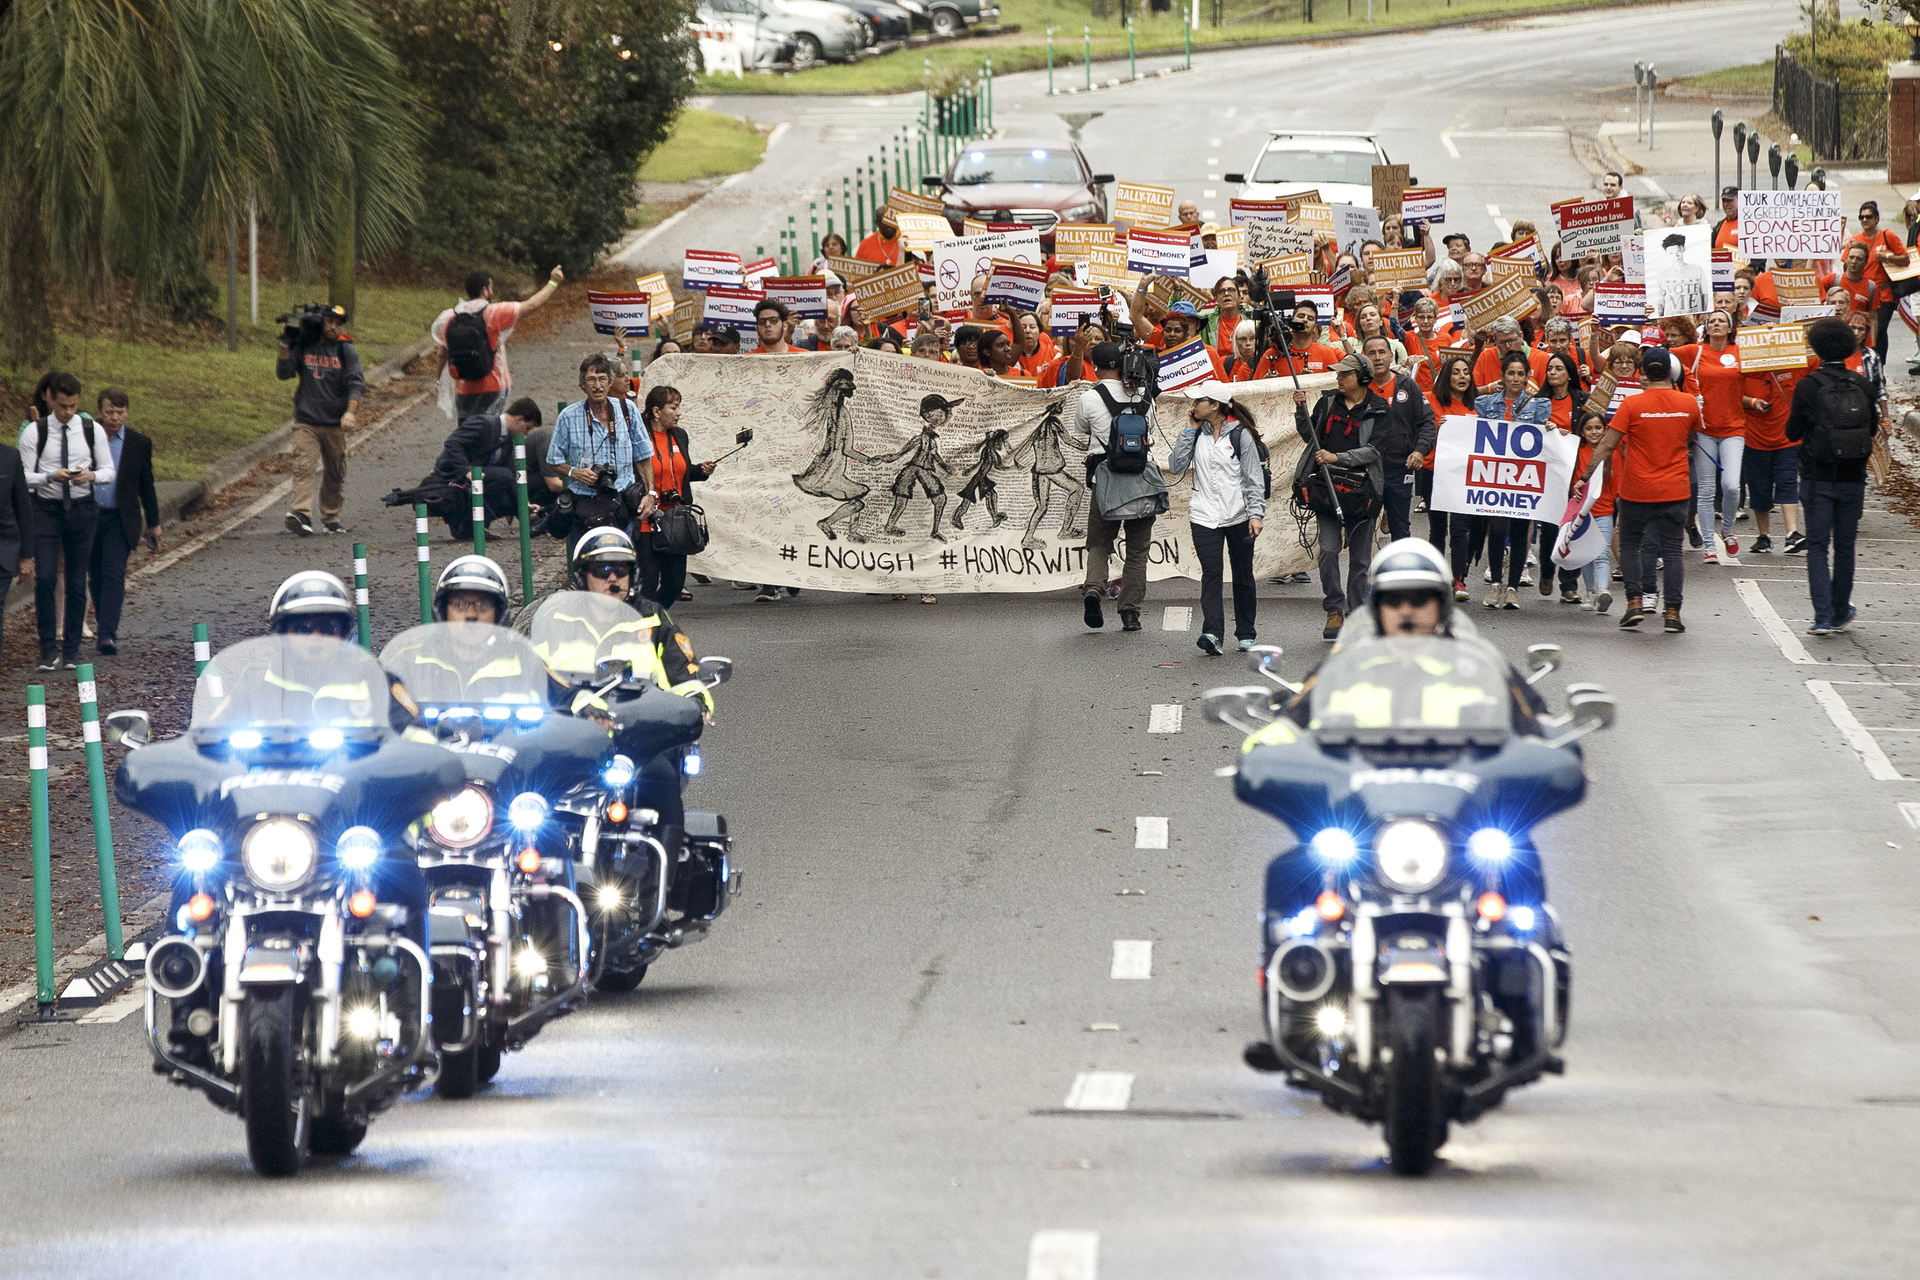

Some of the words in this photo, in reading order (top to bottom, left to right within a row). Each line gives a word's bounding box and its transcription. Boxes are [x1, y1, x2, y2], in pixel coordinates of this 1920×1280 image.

[1372, 166, 1409, 183] POLICY
[1117, 188, 1173, 207] RALLY-TALLY
[1380, 184, 1400, 198] AND
[1743, 193, 1768, 206] YOUR
[1773, 192, 1839, 207] COMPLACENCY
[1414, 205, 1427, 213] NRA
[1571, 202, 1610, 215] NOBODY
[1791, 207, 1805, 219] IS
[900, 219, 952, 232] RALLY-TALLY
[1567, 217, 1593, 228] above
[1594, 214, 1608, 223] the
[1608, 213, 1626, 221] law.
[1744, 218, 1840, 235] DOMESTIC
[1248, 221, 1263, 235] You
[1576, 223, 1619, 236] CONGRESS
[957, 238, 973, 247] HAVE
[974, 233, 1008, 245] CHANGED.
[973, 243, 991, 252] GUNS
[992, 243, 1007, 251] HAVE
[1008, 237, 1040, 247] CHANGED.
[1056, 231, 1116, 244] RALLY-TALLY
[1576, 240, 1588, 248] Do
[1588, 236, 1606, 245] Your
[1739, 233, 1842, 255] TERRORISM
[1132, 247, 1142, 255] NO
[1142, 248, 1159, 258] NRA
[1159, 251, 1186, 259] MONEY
[1571, 250, 1586, 259] and
[1374, 254, 1423, 270] RALLY-TALLY
[854, 268, 918, 301] RALLY-TALLY
[1092, 277, 1140, 287] #GunReformN
[1666, 282, 1699, 295] VOTE
[938, 289, 956, 302] OUR
[959, 289, 972, 297] GU
[1465, 276, 1525, 319] RALLY-TALLY
[1669, 292, 1698, 310] ME
[1738, 330, 1804, 348] RALLY-TALLY
[1744, 357, 1801, 367] #GunReformNow
[1474, 420, 1543, 459] NO
[1471, 459, 1541, 489] NRA
[1466, 488, 1542, 510] MONEY
[1475, 508, 1530, 517] NONRAMONEY.ORG
[220, 769, 347, 801] POLICE
[1349, 766, 1480, 795] POLICE
